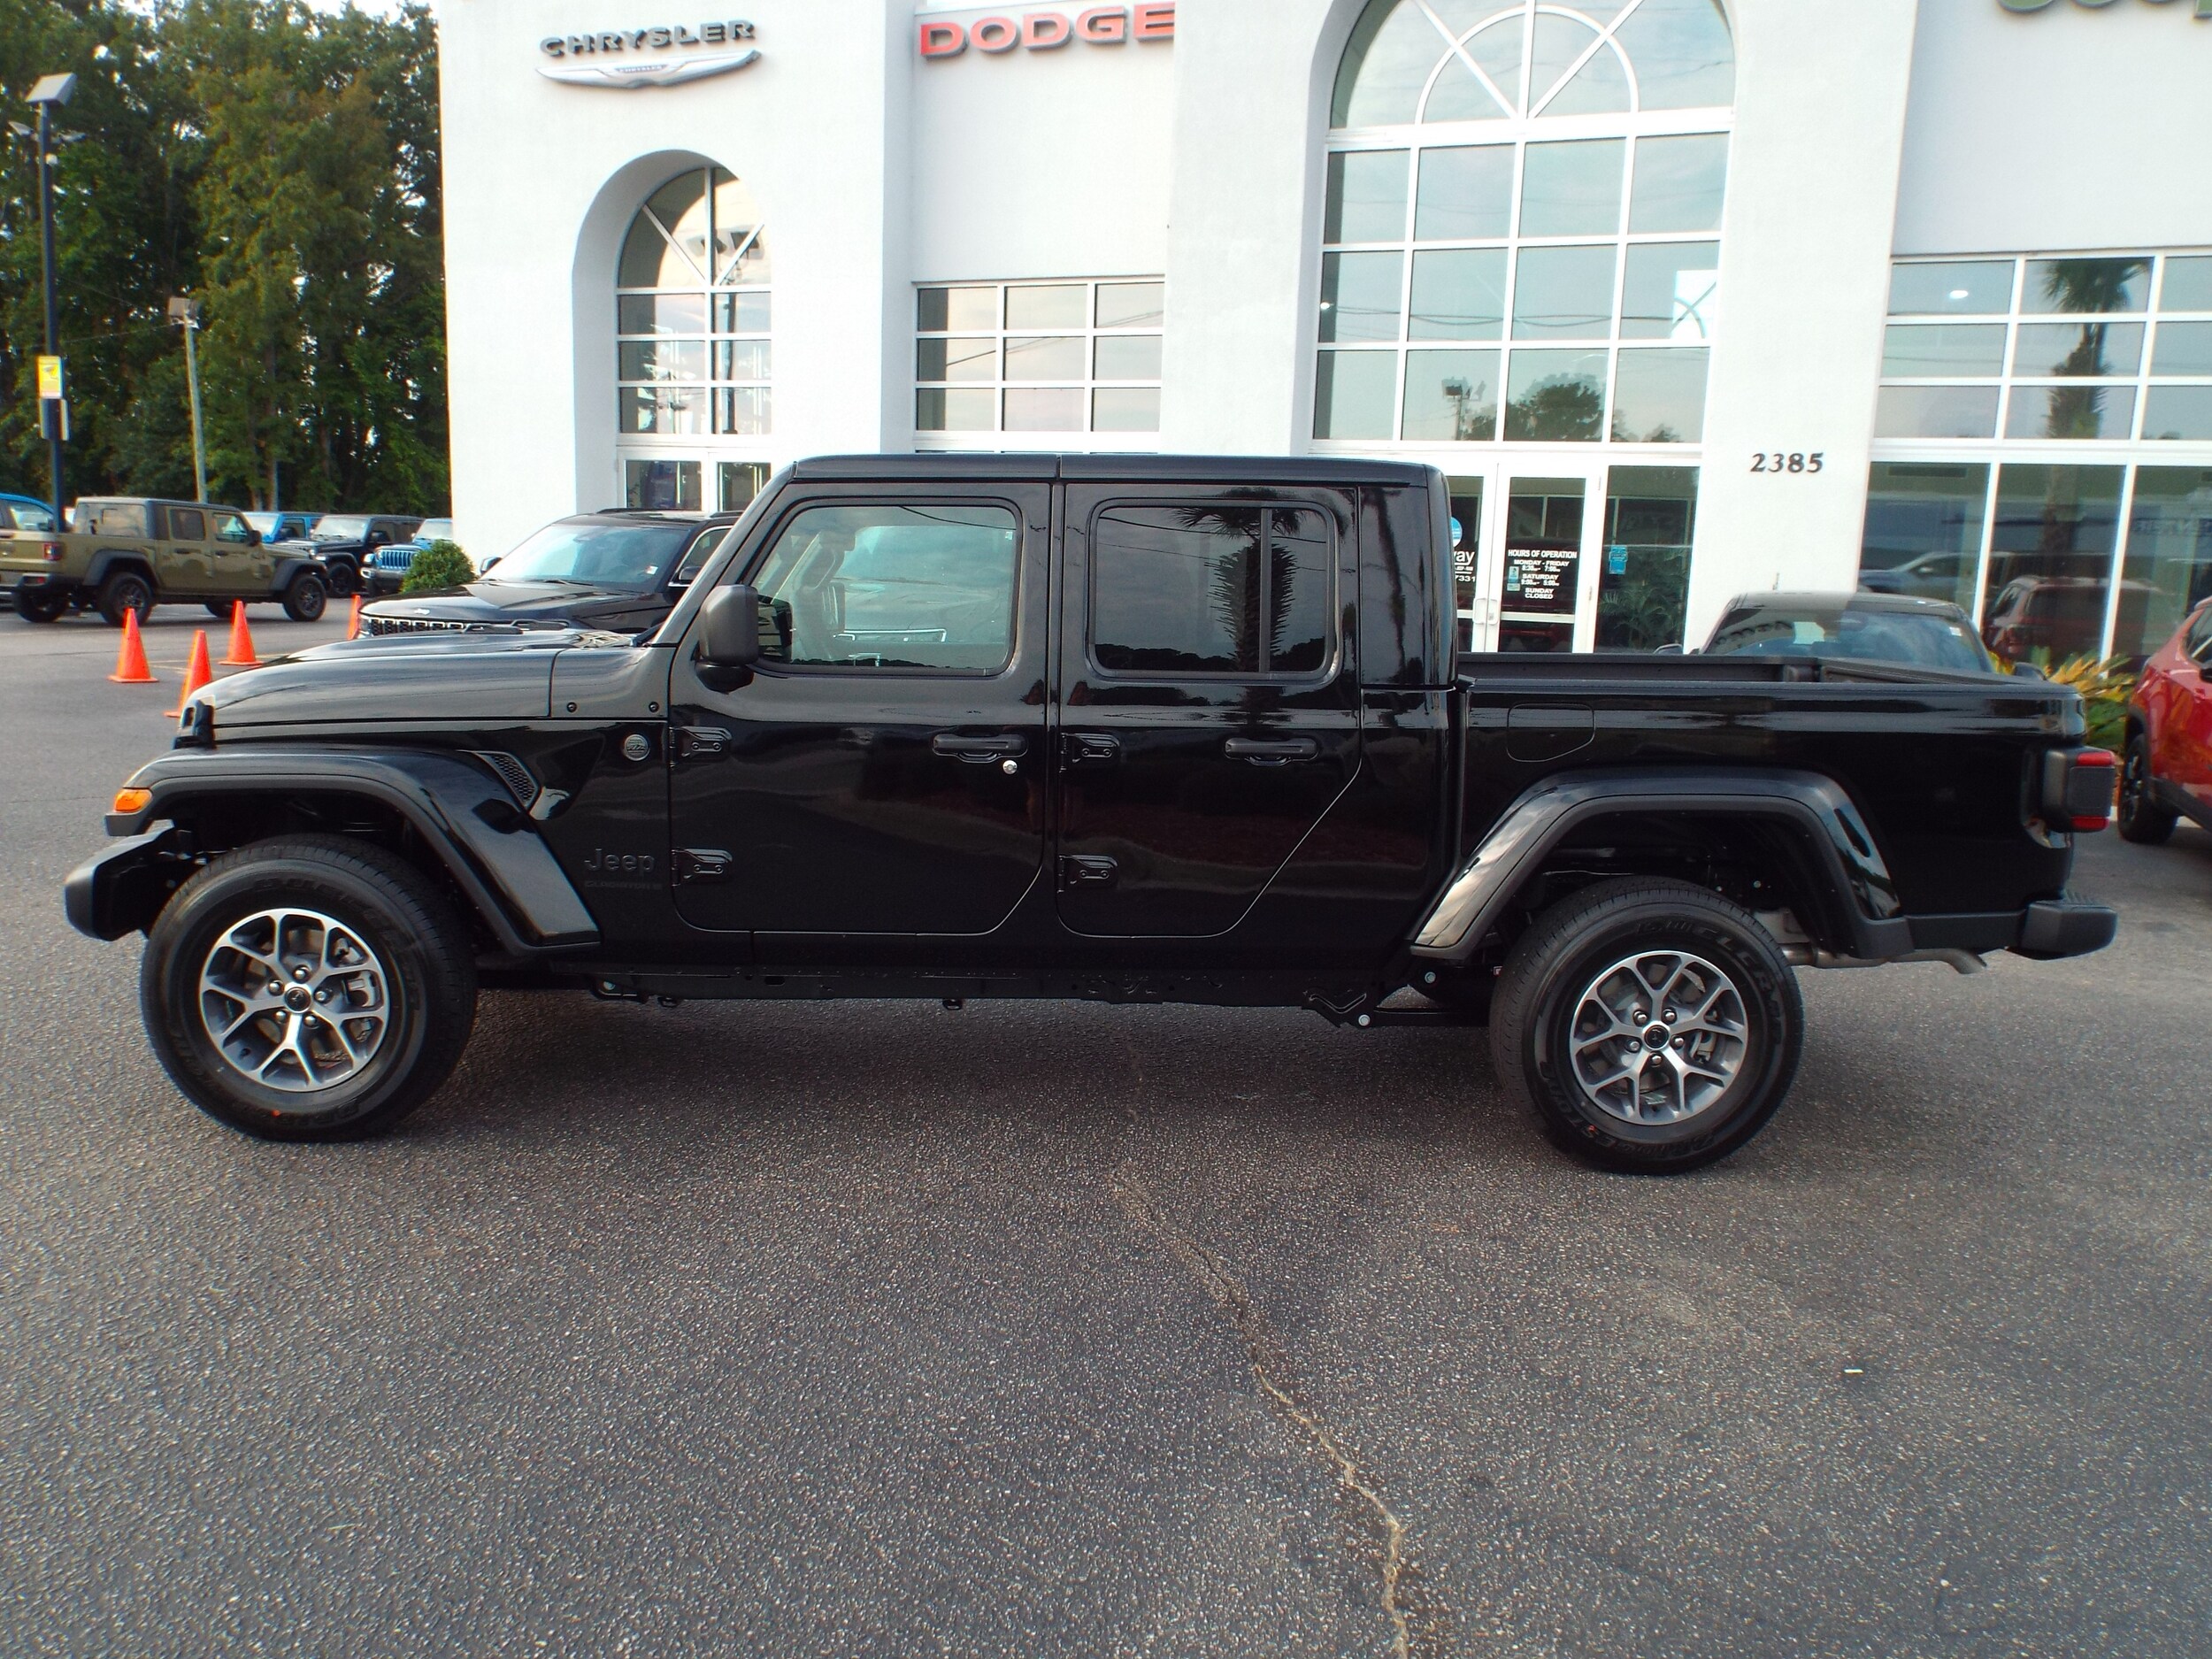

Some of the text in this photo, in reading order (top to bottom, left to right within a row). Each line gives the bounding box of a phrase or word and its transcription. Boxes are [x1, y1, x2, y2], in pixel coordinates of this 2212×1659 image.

[540, 19, 755, 57] CHRYSLER
[919, 2, 1175, 61] DODGE
[1750, 452, 1824, 473] 2385
[1540, 550, 1578, 559] OPERATION
[584, 848, 655, 878] Jeep
